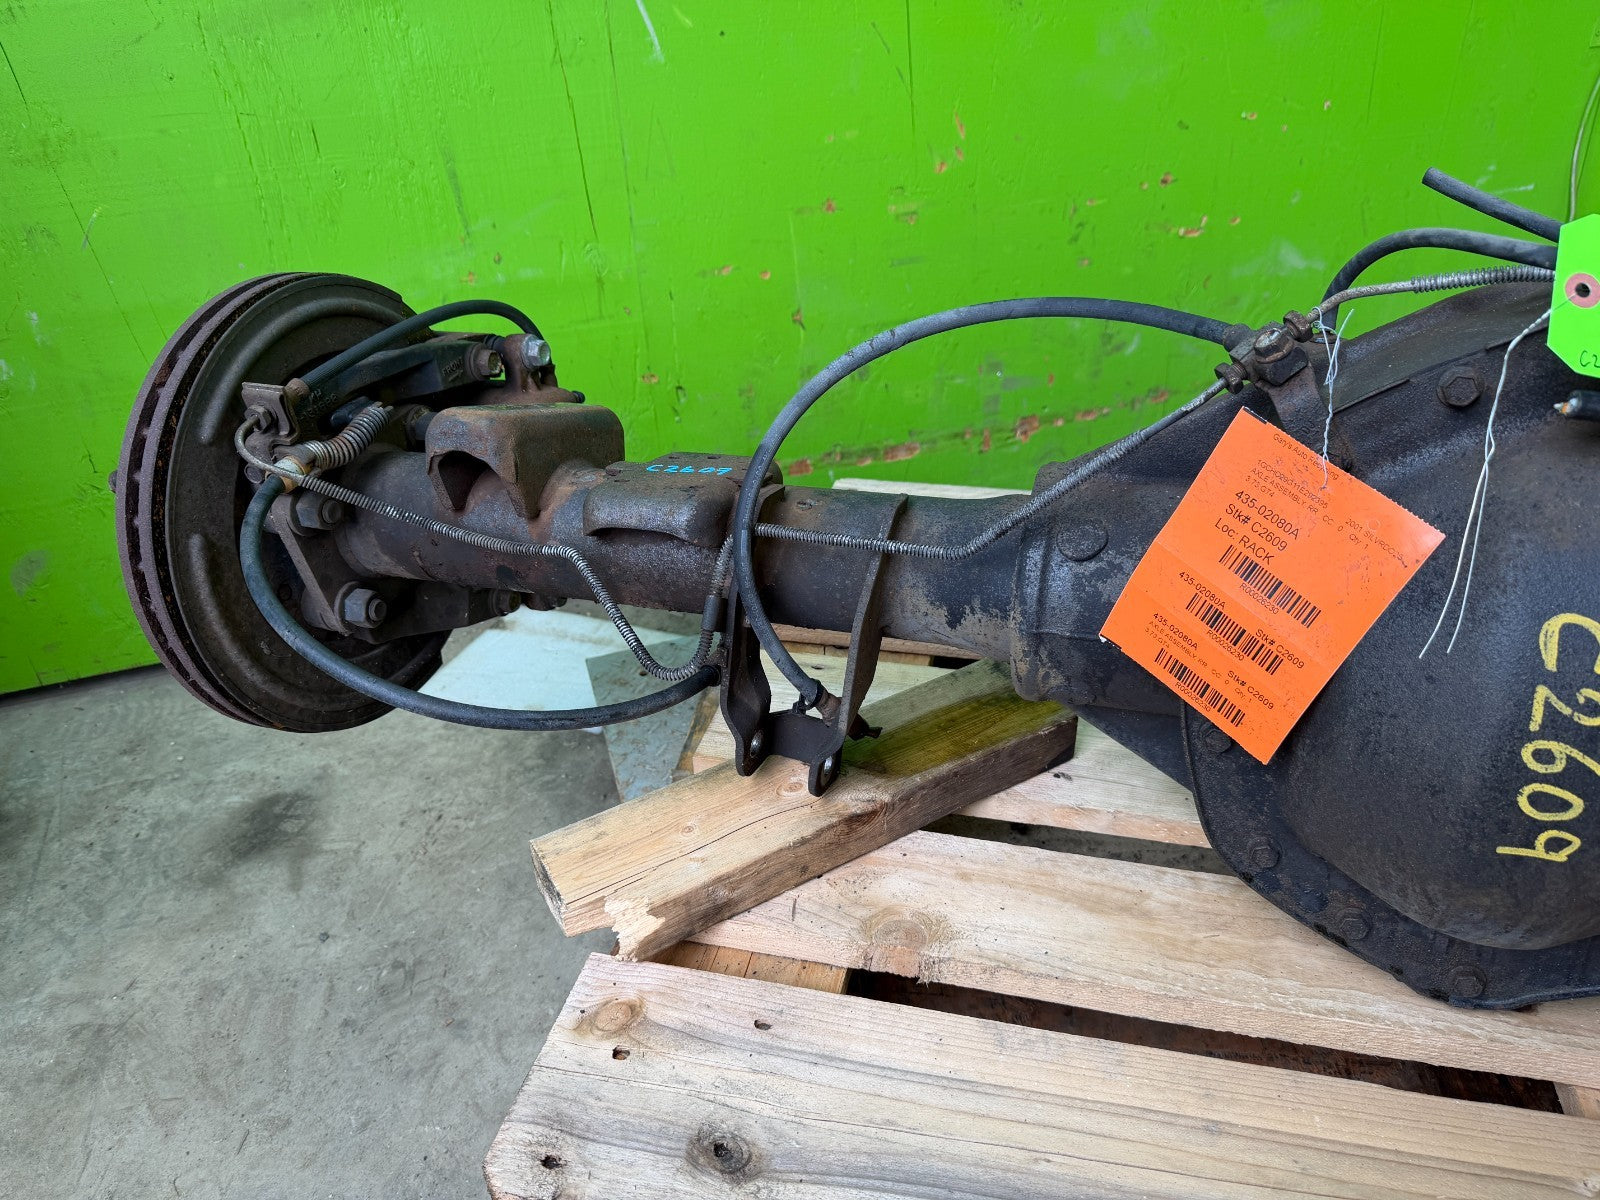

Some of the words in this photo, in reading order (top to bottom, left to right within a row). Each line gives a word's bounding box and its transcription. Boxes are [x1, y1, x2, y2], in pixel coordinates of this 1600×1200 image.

[646, 464, 733, 475] C2609
[1292, 446, 1308, 459] Auto
[1250, 467, 1269, 482] AXLE
[1224, 503, 1251, 525] Stk#
[1249, 521, 1288, 552] C2609
[1234, 488, 1301, 539] 435-02080A
[1214, 517, 1239, 539] Loc:
[1238, 535, 1274, 564] RACK
[1177, 570, 1227, 609] 435-02080A
[1238, 582, 1279, 614] R00026230
[1152, 612, 1199, 650] 435-02080A
[1254, 628, 1275, 646] Stk#
[1274, 644, 1305, 669] C2609
[1227, 670, 1246, 687] Stk#
[1246, 685, 1275, 709] C2609
[1496, 613, 1600, 862] C2609
